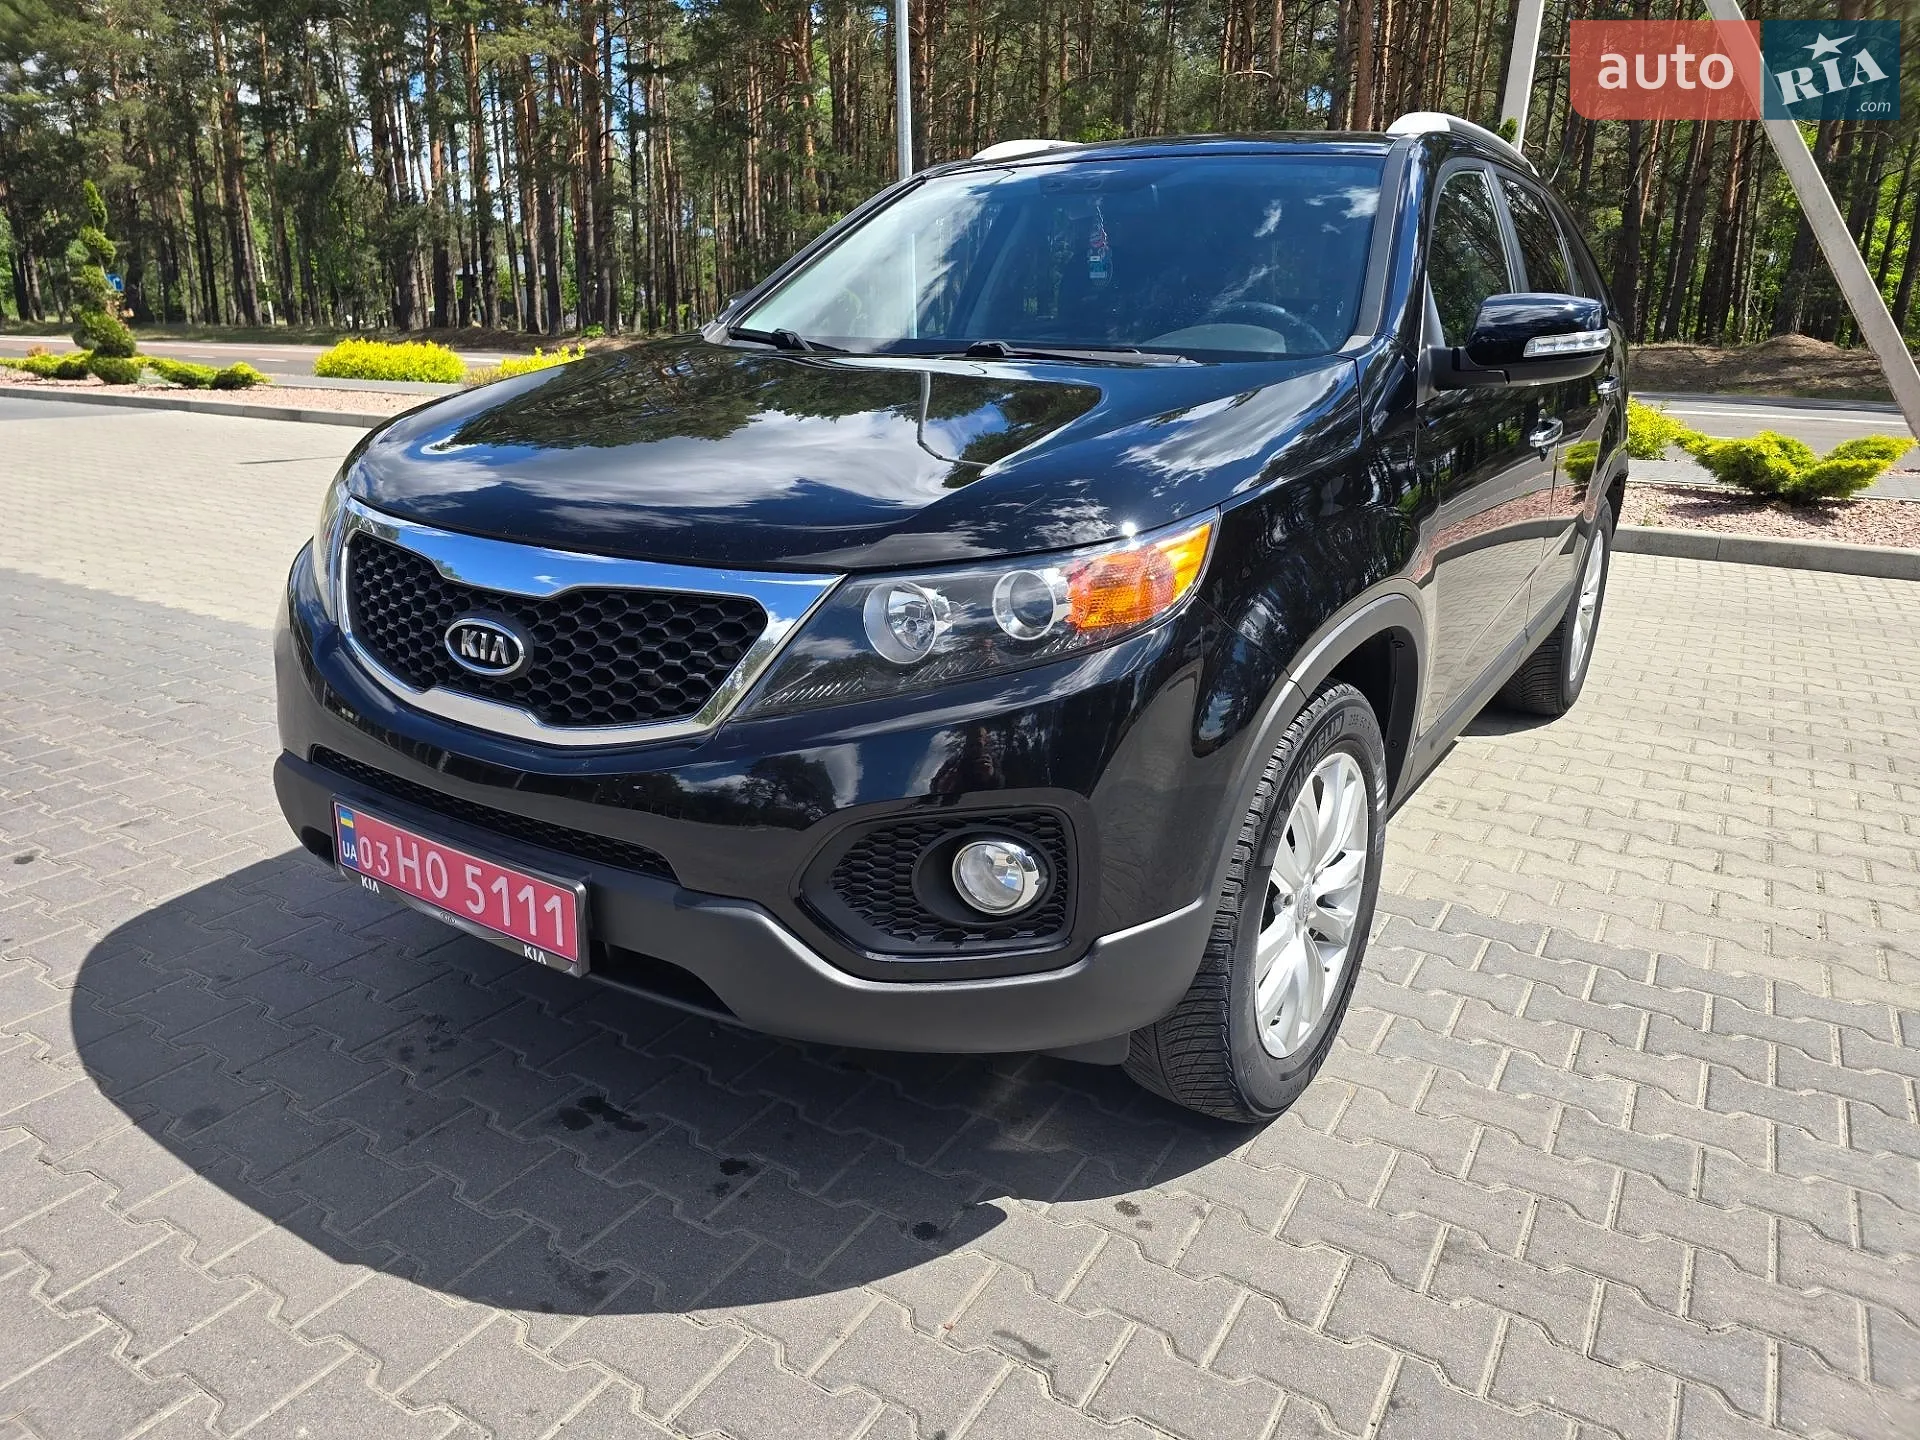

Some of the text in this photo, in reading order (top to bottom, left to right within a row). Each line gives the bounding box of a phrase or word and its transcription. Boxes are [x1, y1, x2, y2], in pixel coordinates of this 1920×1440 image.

[461, 628, 511, 665] KIA
[342, 840, 358, 862] UA
[361, 874, 380, 894] KIA
[464, 863, 564, 947] 5111
[523, 943, 547, 966] KIA
